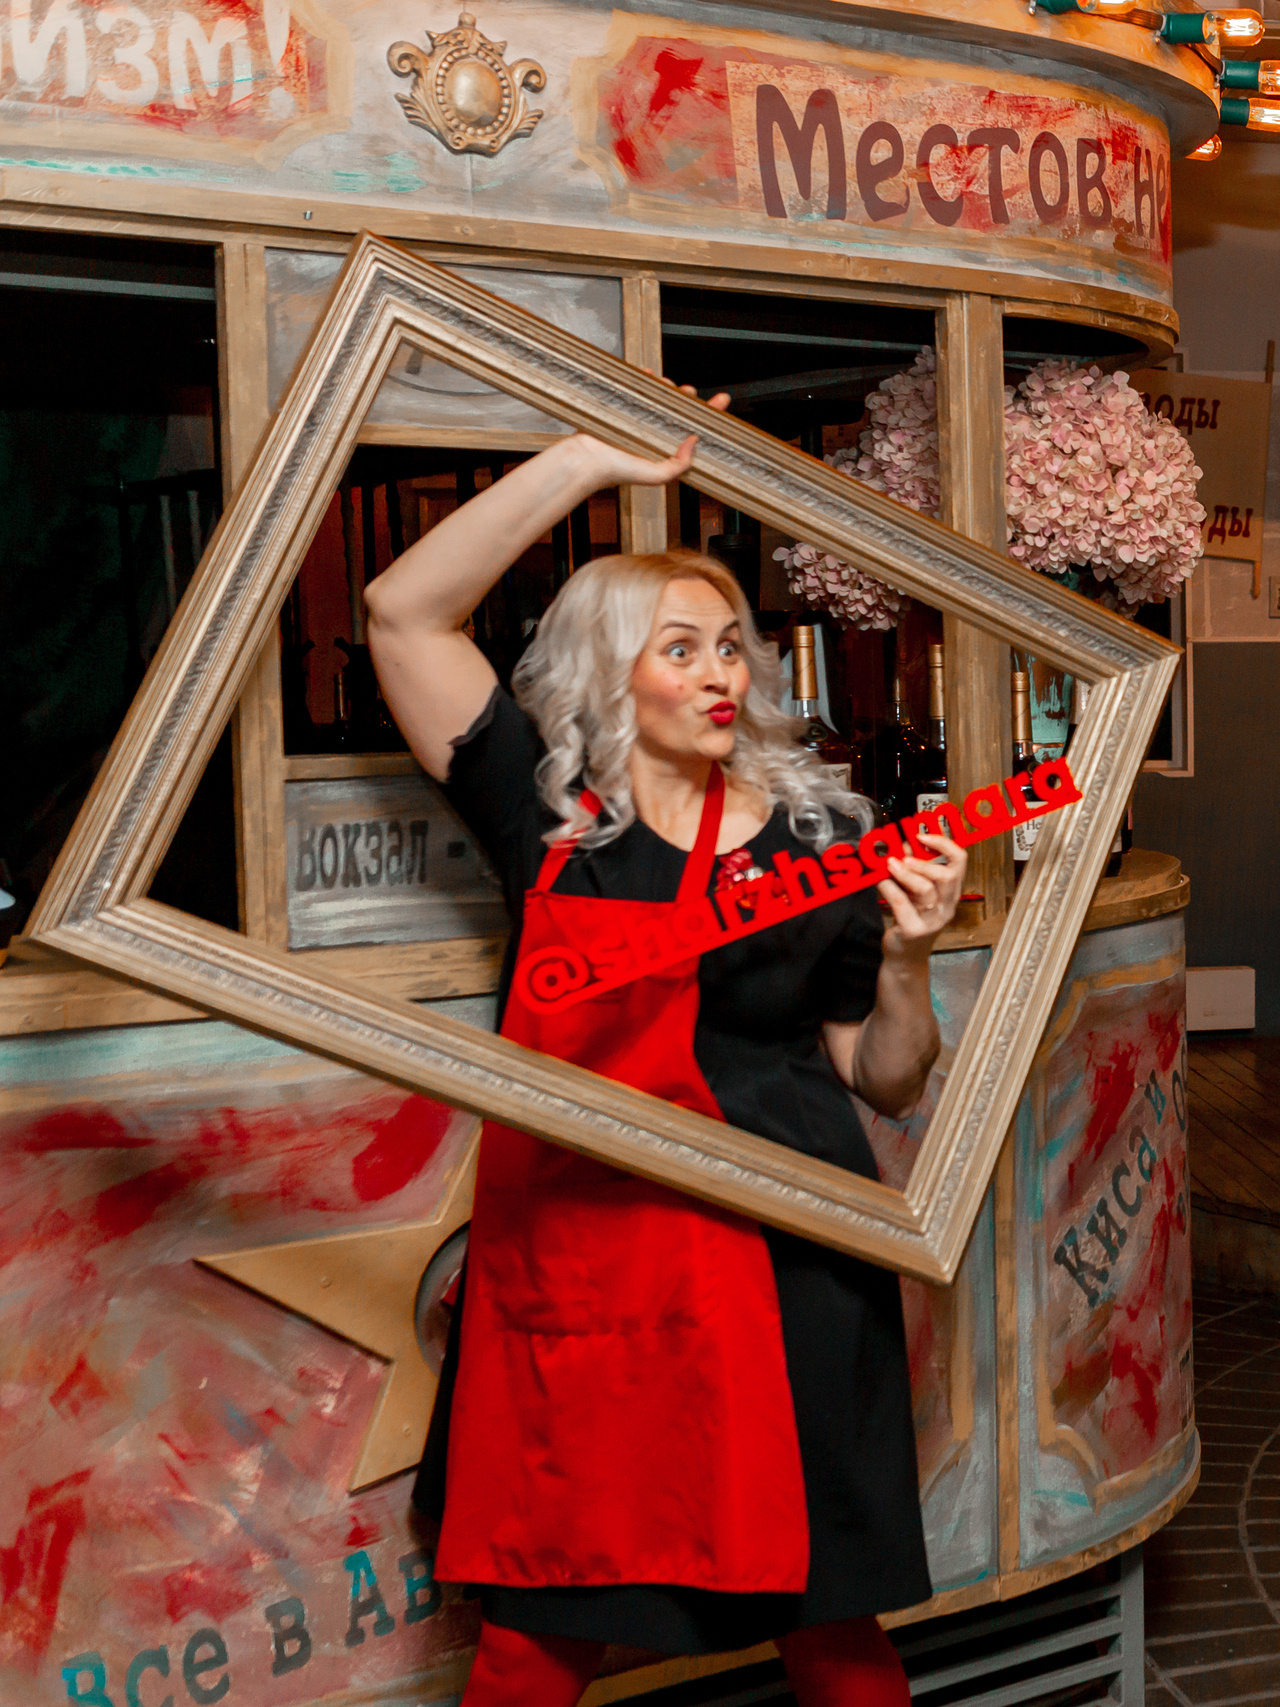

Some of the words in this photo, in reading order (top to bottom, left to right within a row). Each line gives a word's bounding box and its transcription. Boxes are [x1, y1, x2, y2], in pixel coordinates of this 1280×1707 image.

[756, 85, 1112, 226] Местов
[1134, 146, 1169, 239] Не
[1200, 505, 1253, 545] ды
[1027, 820, 1042, 831] He
[516, 756, 1083, 1015] @sharzhsamara
